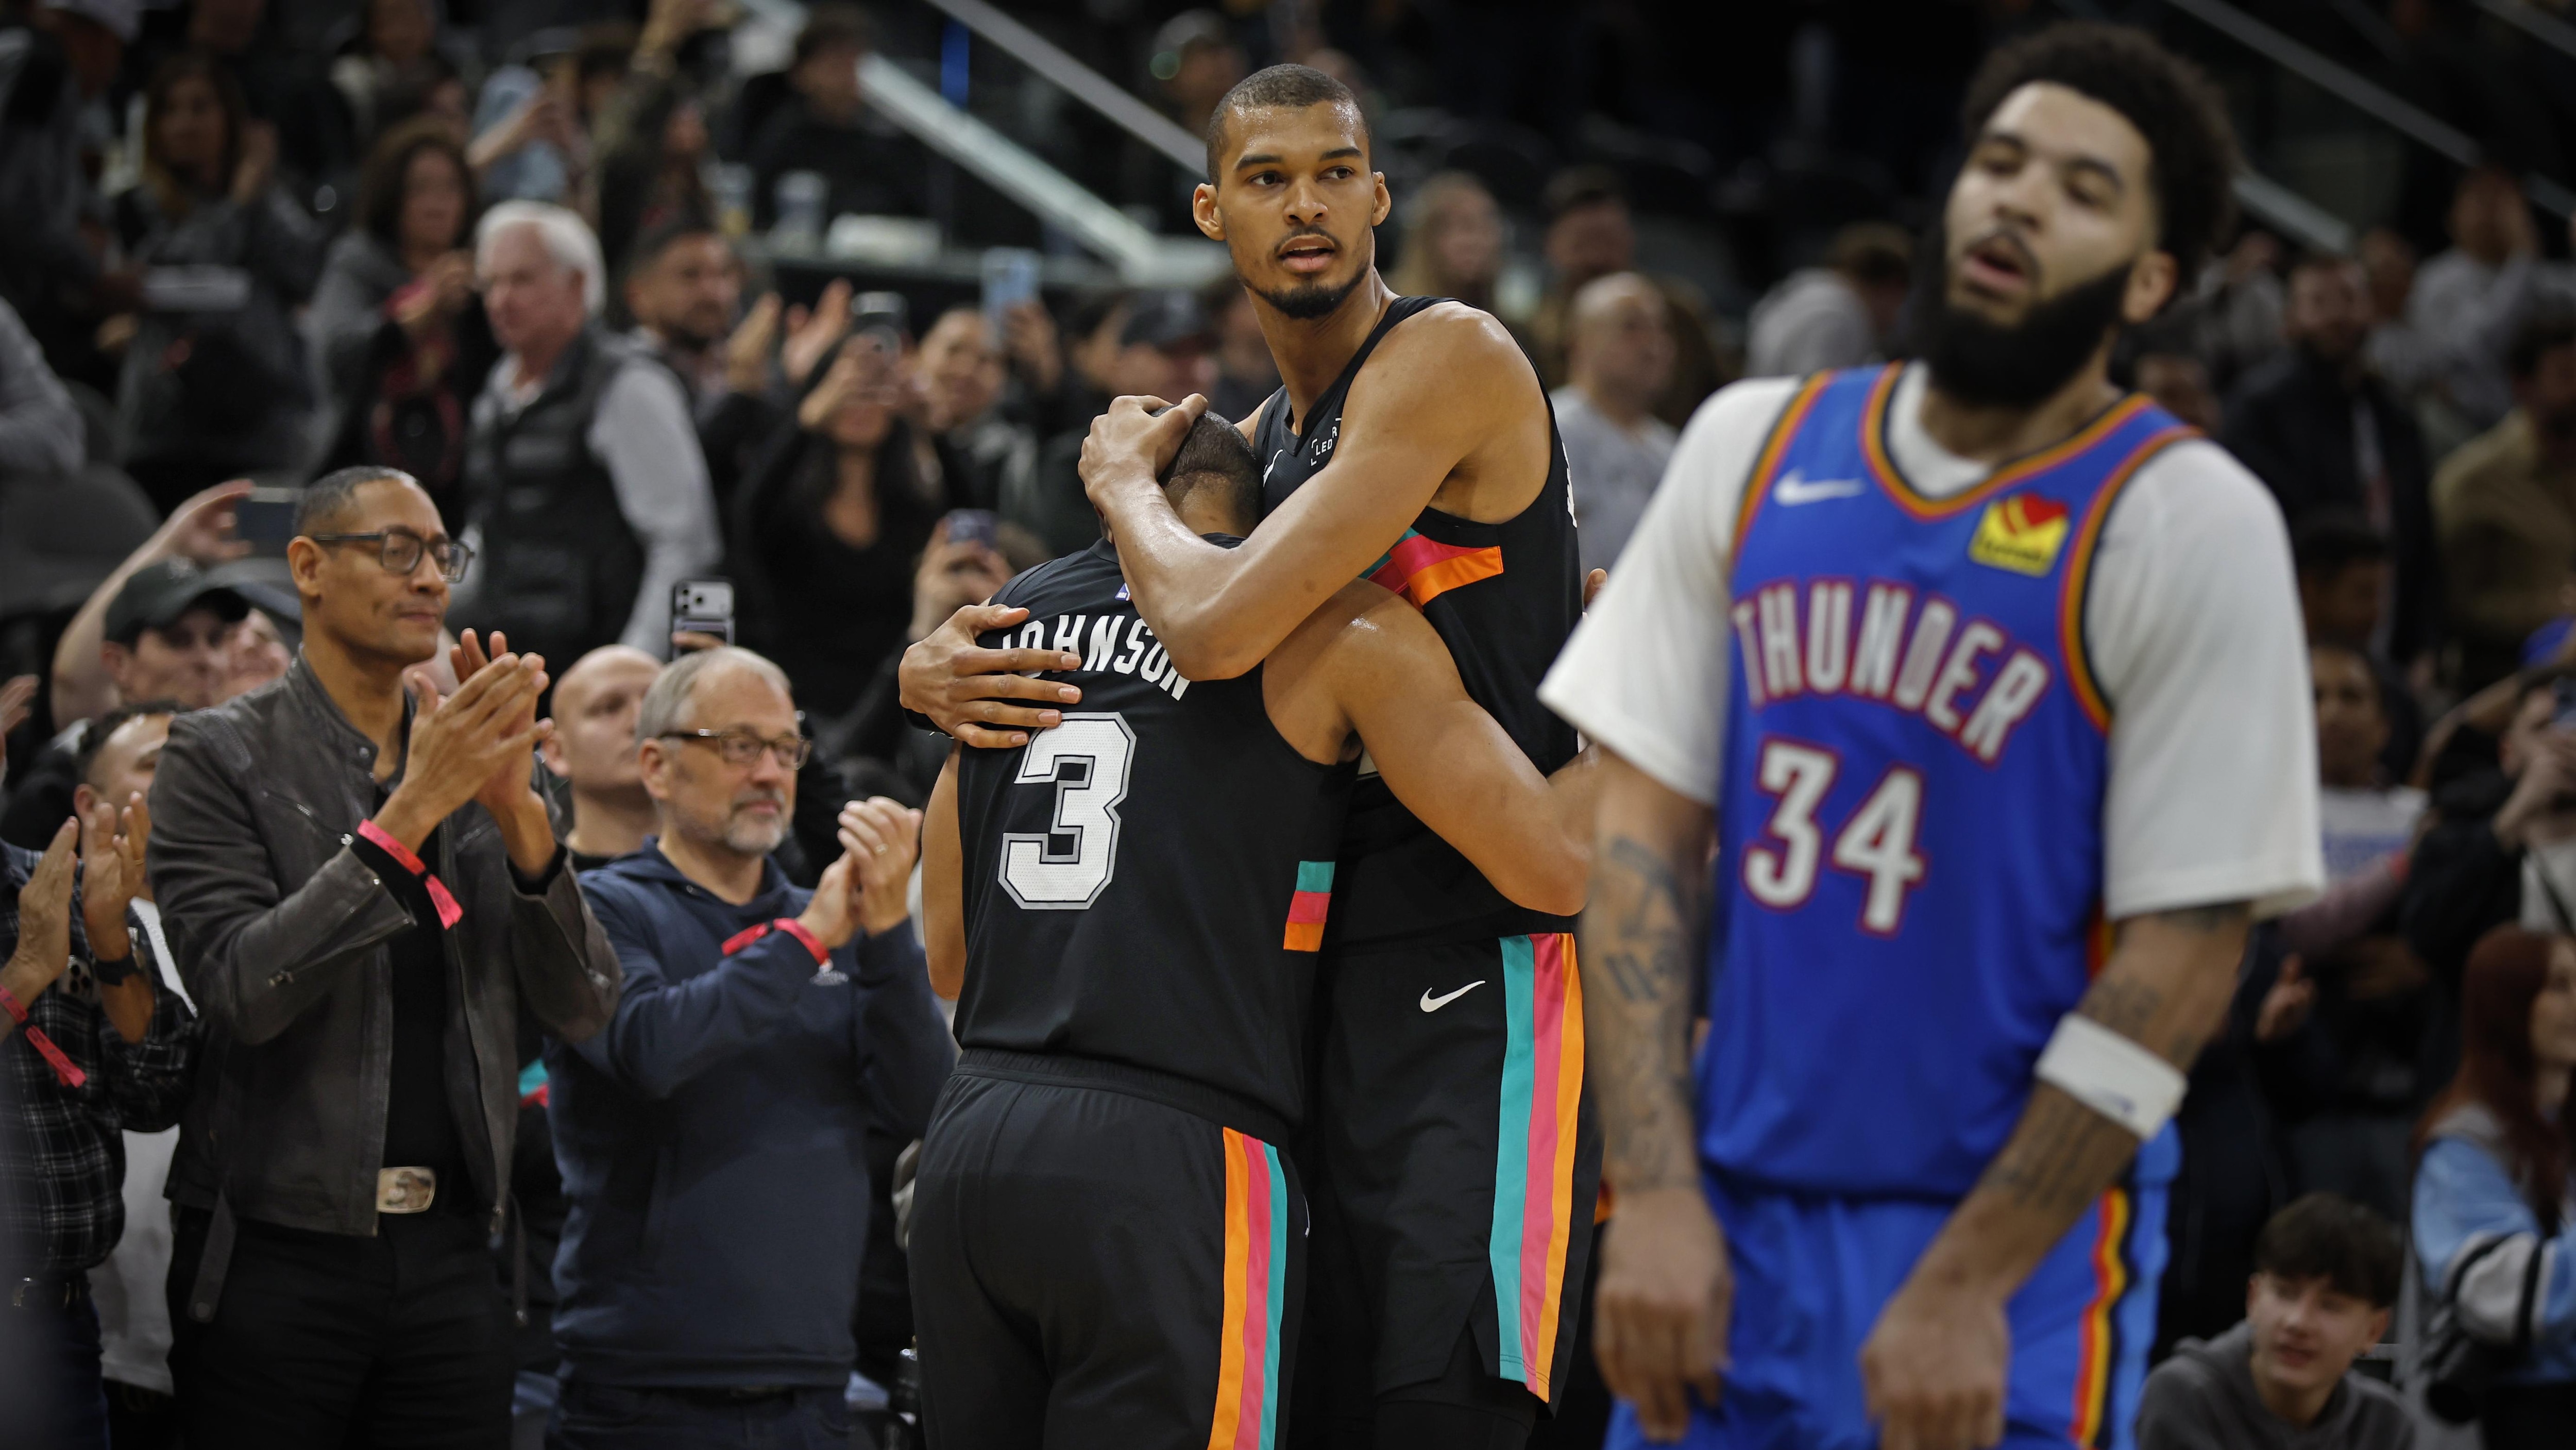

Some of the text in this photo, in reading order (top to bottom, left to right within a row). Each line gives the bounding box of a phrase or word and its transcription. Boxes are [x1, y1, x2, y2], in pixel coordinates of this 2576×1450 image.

[1731, 578, 2050, 766] THUNDER
[998, 712, 1137, 910] 3
[1743, 737, 1925, 935] 34
